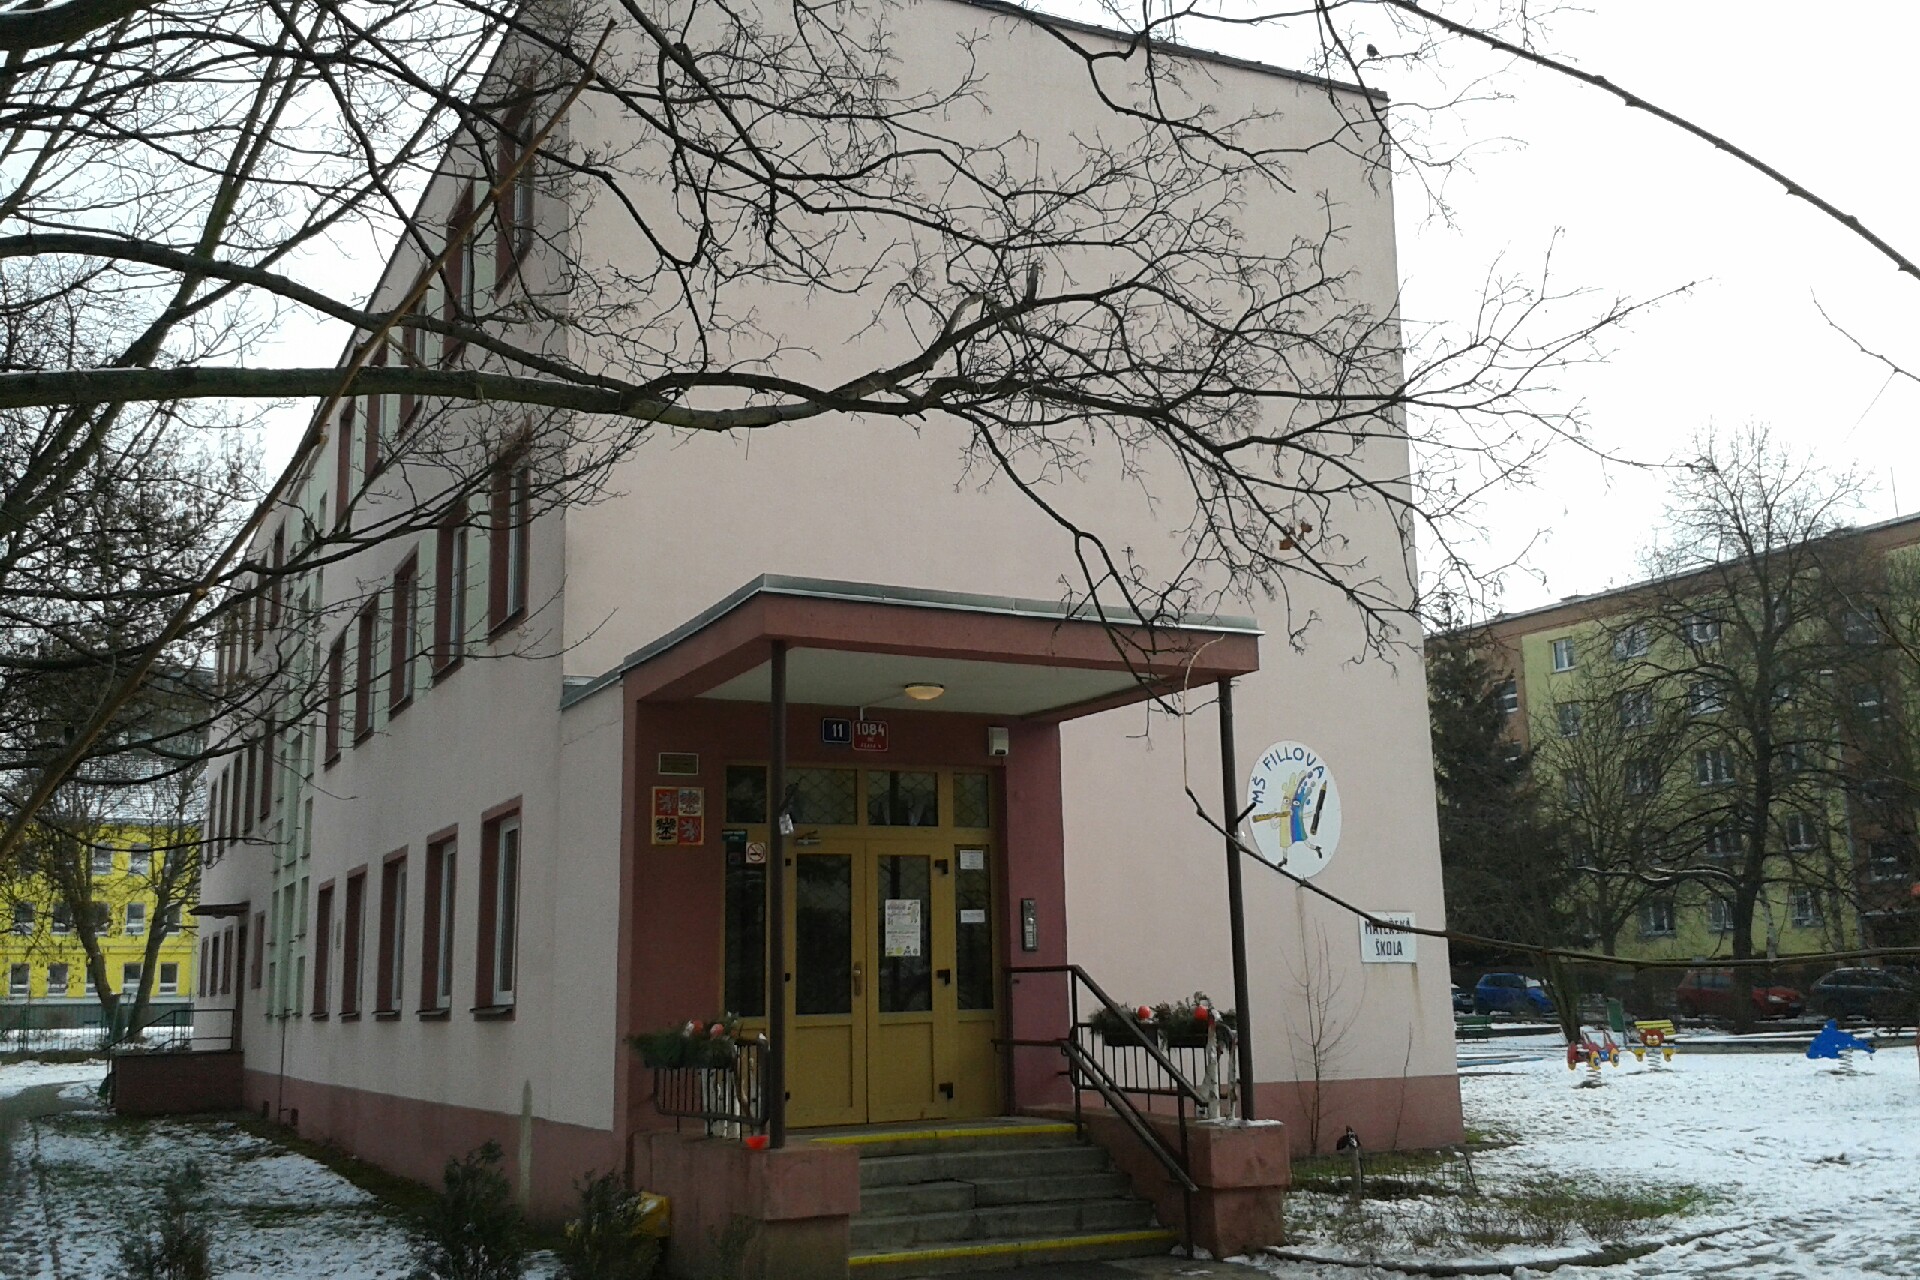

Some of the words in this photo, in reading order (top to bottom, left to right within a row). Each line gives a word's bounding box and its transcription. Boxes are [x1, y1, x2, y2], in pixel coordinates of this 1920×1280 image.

[832, 723, 843, 738] 11
[856, 723, 885, 737] 1084
[1252, 775, 1266, 804] MŠ
[1262, 746, 1325, 779] FILLOVA
[1375, 938, 1404, 956] ŠKOLA
